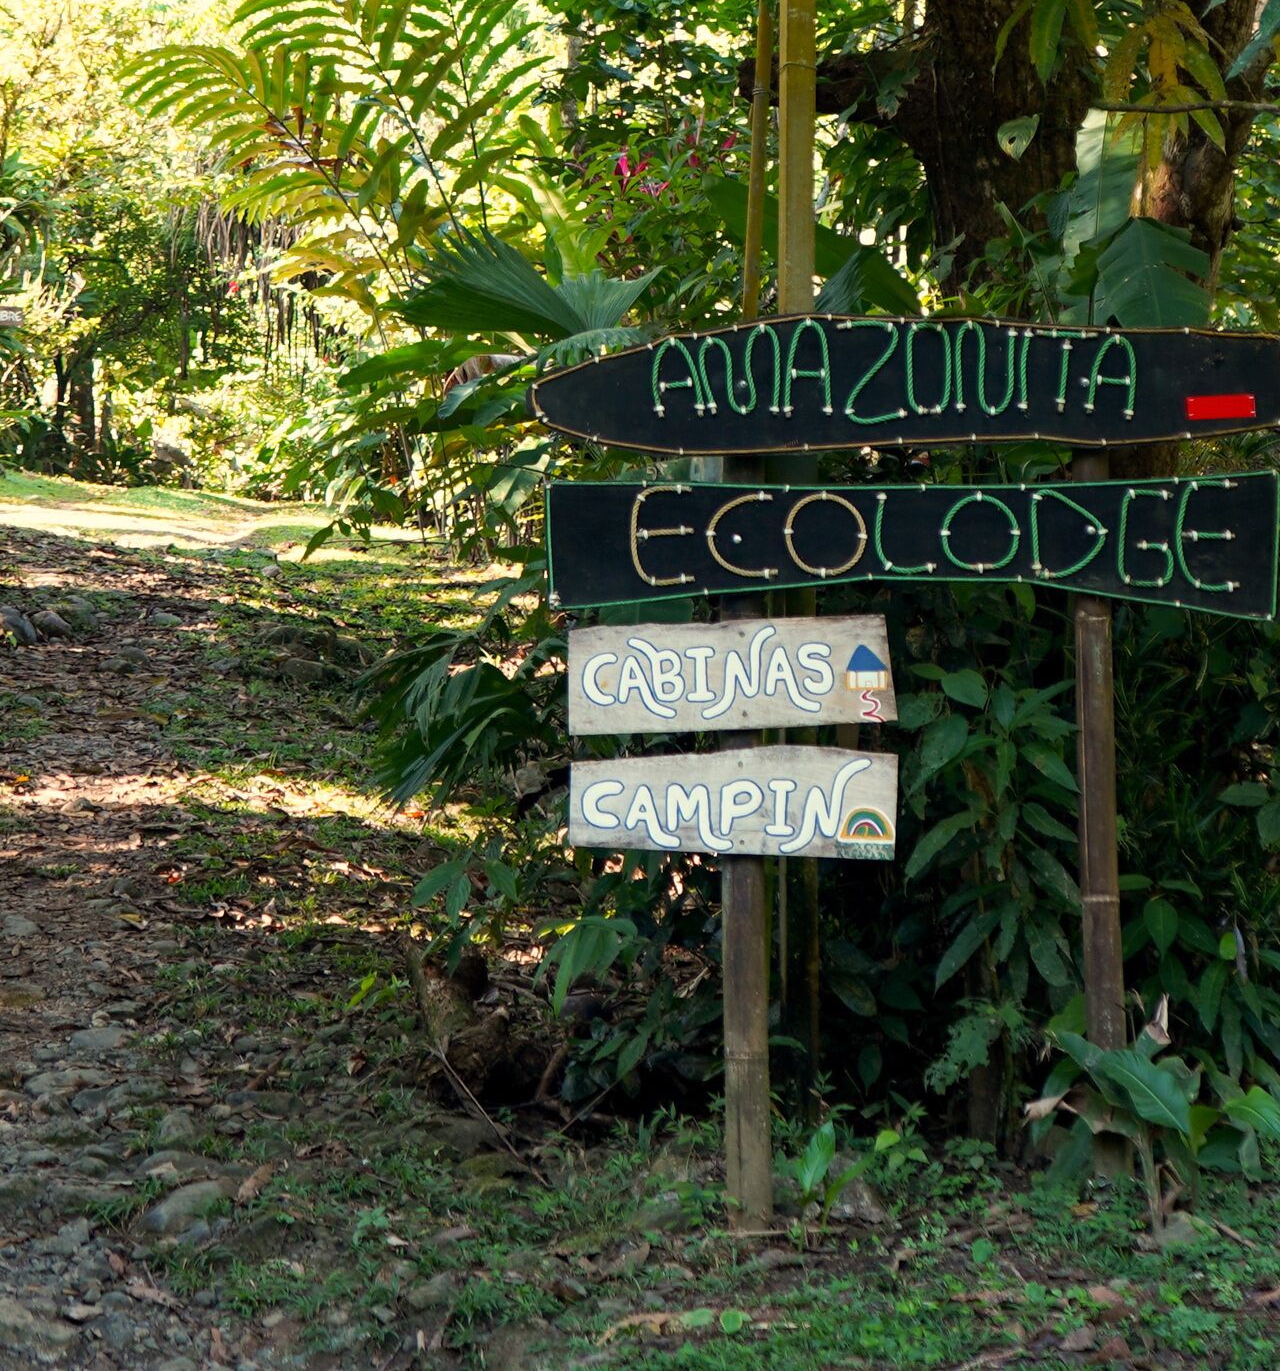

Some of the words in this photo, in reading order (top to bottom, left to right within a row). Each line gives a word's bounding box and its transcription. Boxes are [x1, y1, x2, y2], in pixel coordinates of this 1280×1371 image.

[652, 319, 1136, 424] AMAZONITA
[629, 479, 1241, 592] ECOLODGE
[581, 627, 835, 720] CABINAS
